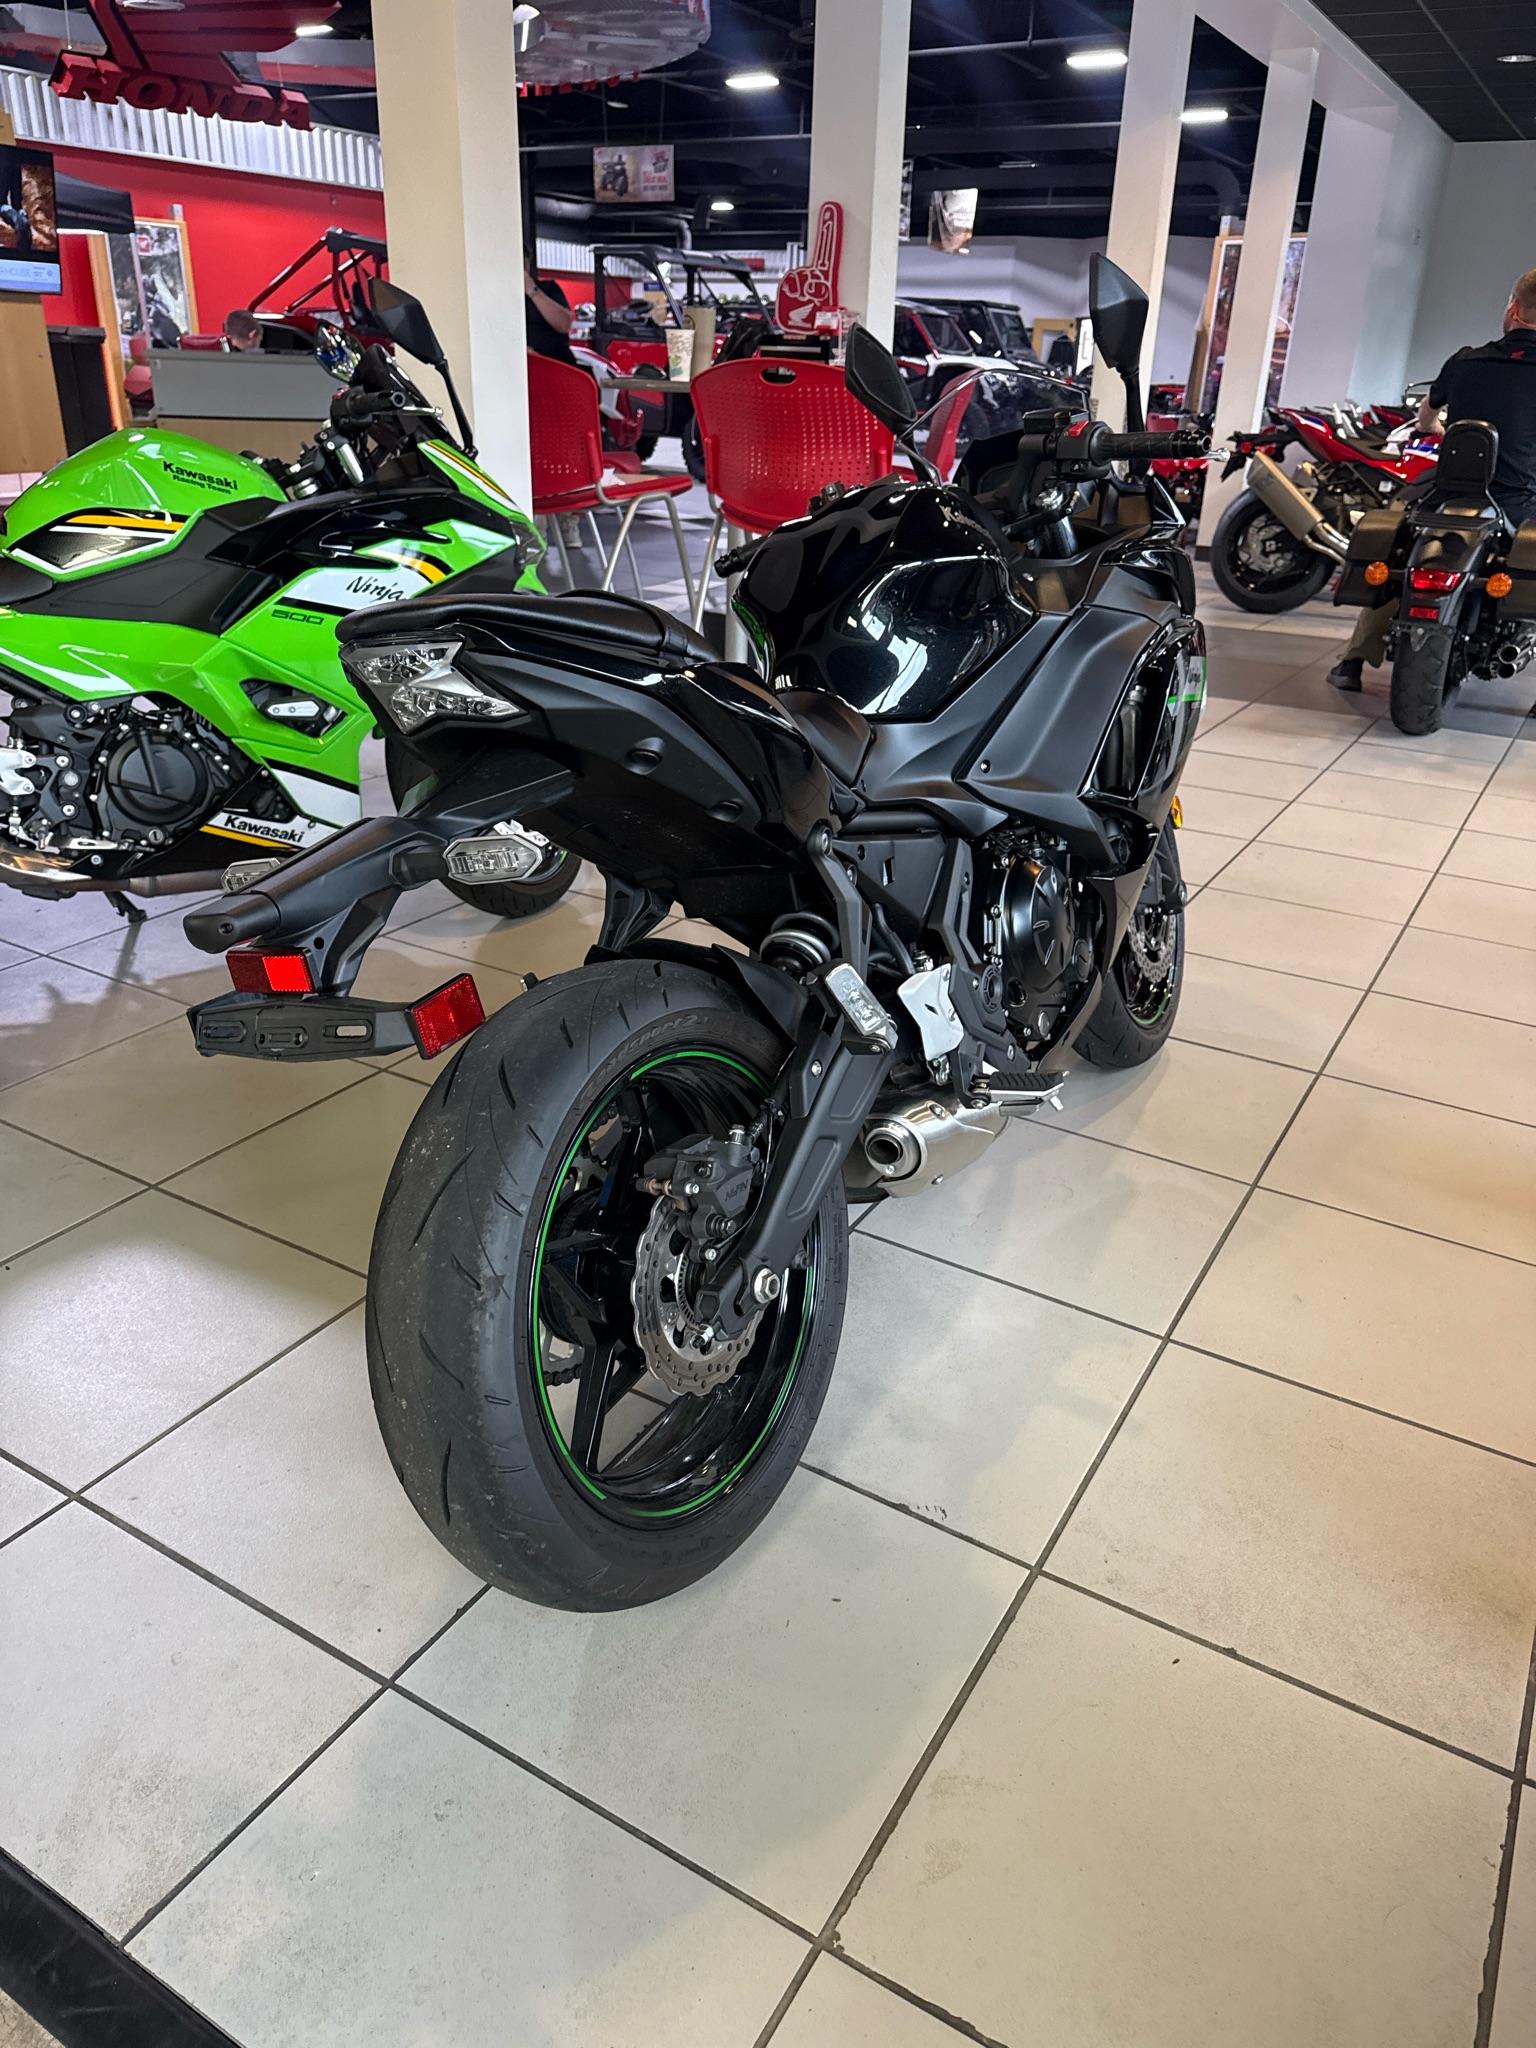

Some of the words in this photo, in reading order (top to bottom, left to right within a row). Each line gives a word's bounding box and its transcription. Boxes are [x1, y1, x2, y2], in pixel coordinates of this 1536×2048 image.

[51, 52, 312, 131] HONDA
[163, 461, 238, 491] Kawasaki
[172, 474, 206, 489] Racing
[206, 482, 231, 495] Team
[346, 576, 404, 603] Ninja
[271, 609, 325, 625] 500
[224, 815, 305, 843] Kawasaki
